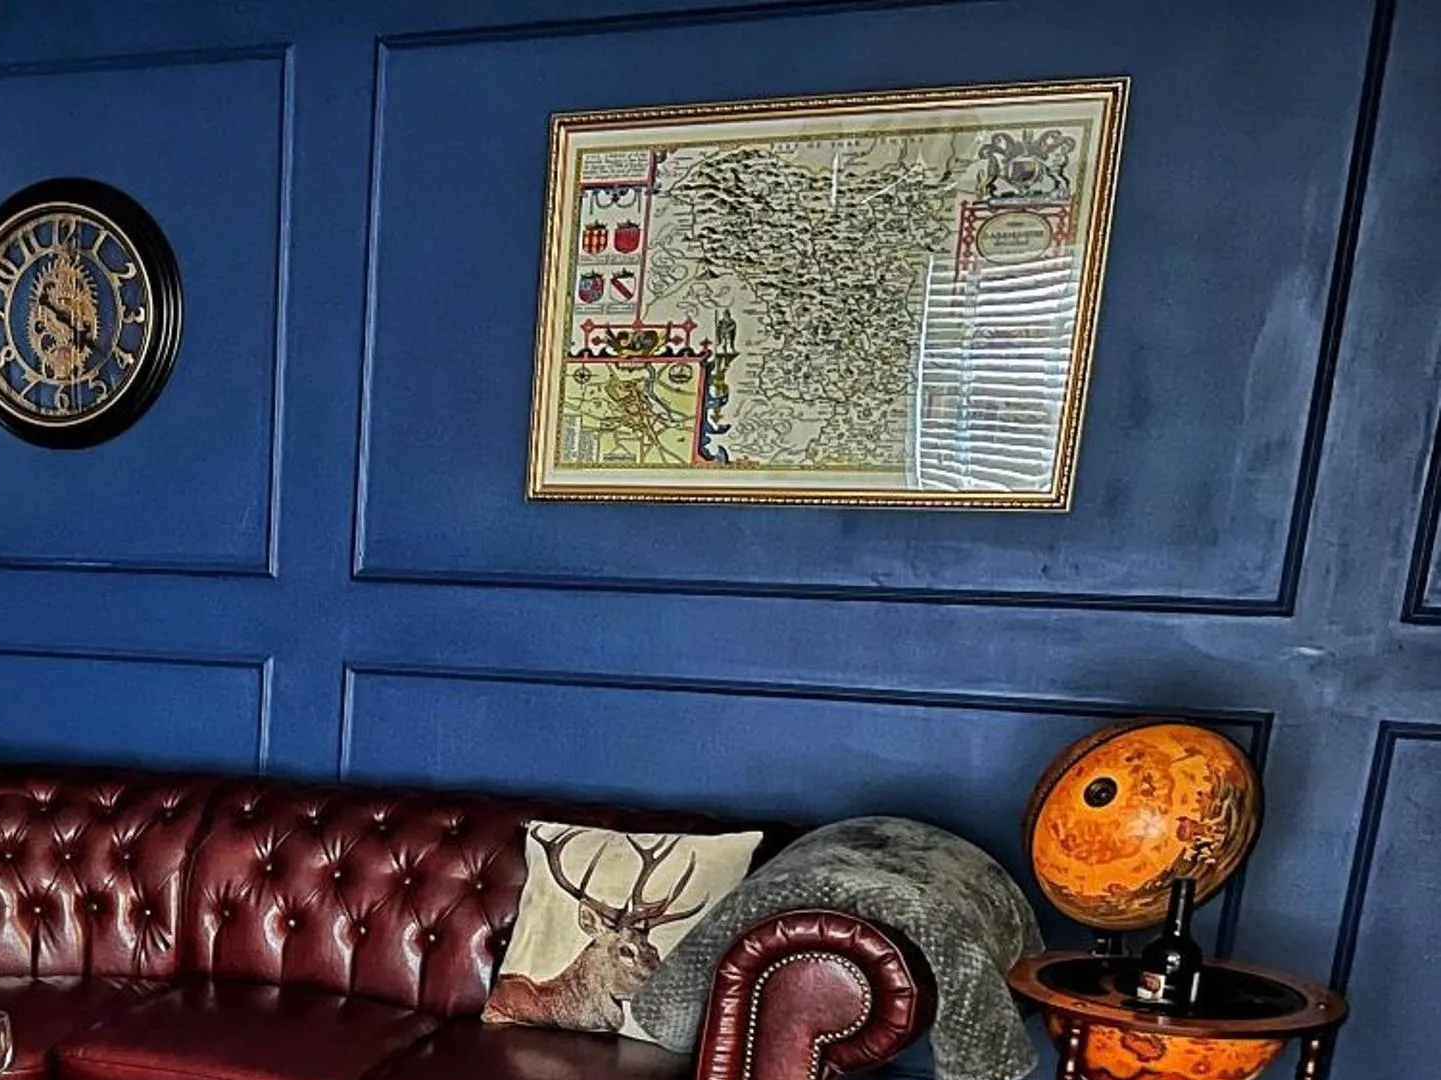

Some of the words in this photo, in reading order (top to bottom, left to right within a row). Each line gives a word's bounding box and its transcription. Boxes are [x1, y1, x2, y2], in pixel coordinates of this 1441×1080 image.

[112, 262, 137, 287] 2
[120, 304, 145, 324] 3
[113, 346, 135, 370] 4
[54, 384, 70, 410] 6
[87, 372, 108, 403] 5
